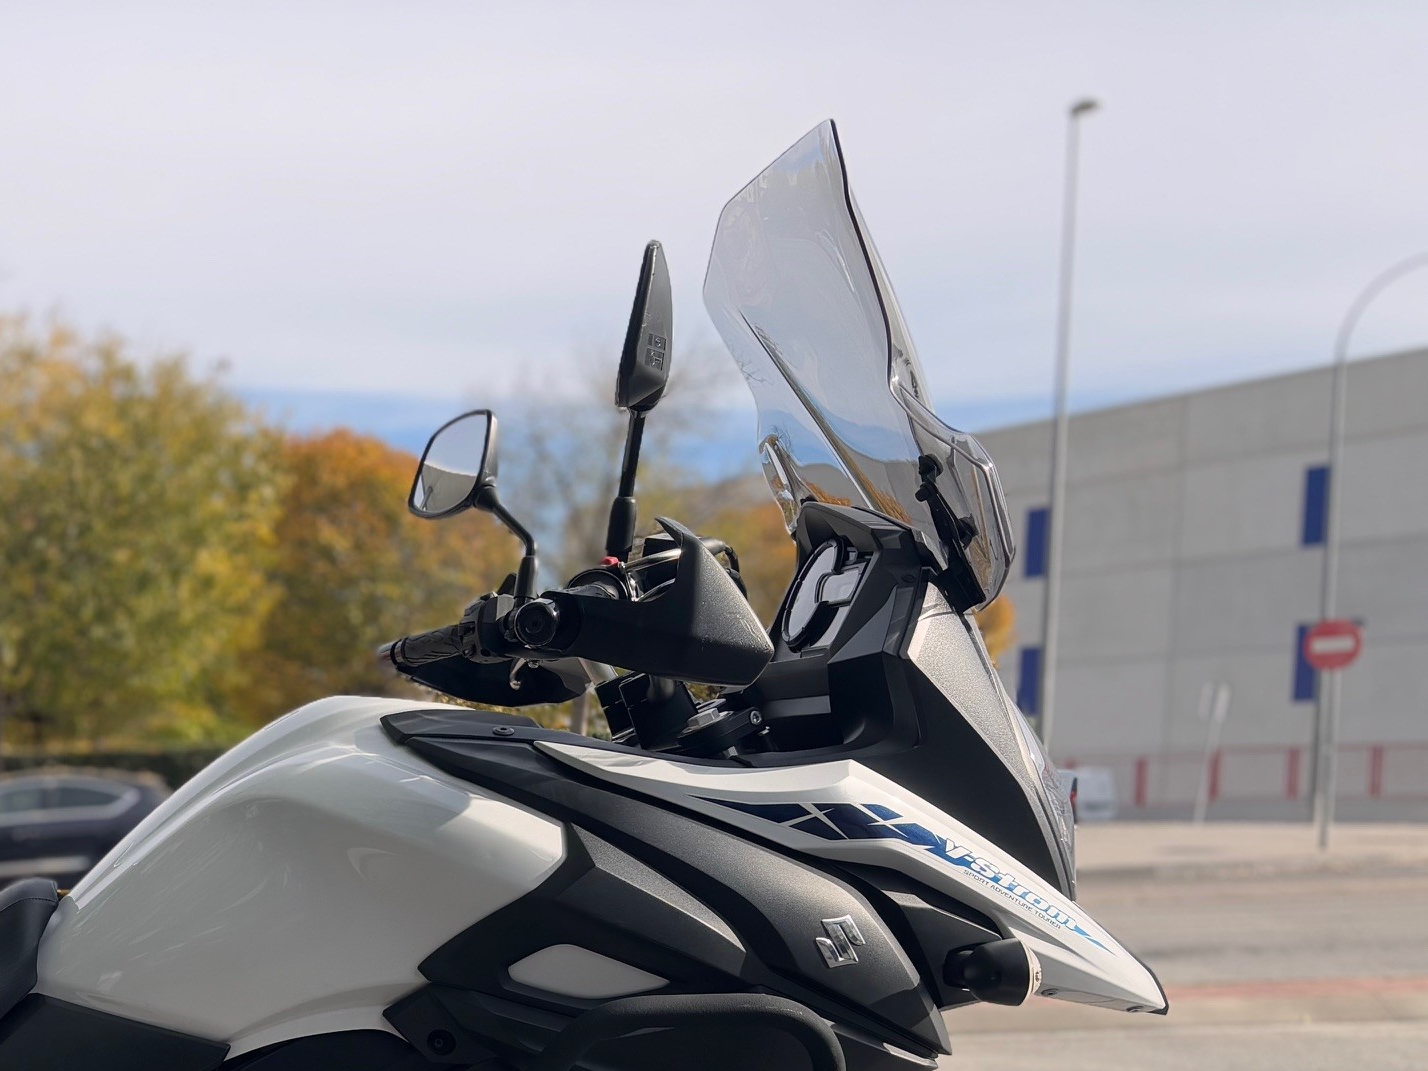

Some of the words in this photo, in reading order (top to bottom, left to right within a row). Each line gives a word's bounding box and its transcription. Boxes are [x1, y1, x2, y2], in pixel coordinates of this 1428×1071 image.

[963, 869, 990, 889] SPORT
[990, 882, 1033, 912] ADVENTURE
[1034, 910, 1062, 930] TOURER
